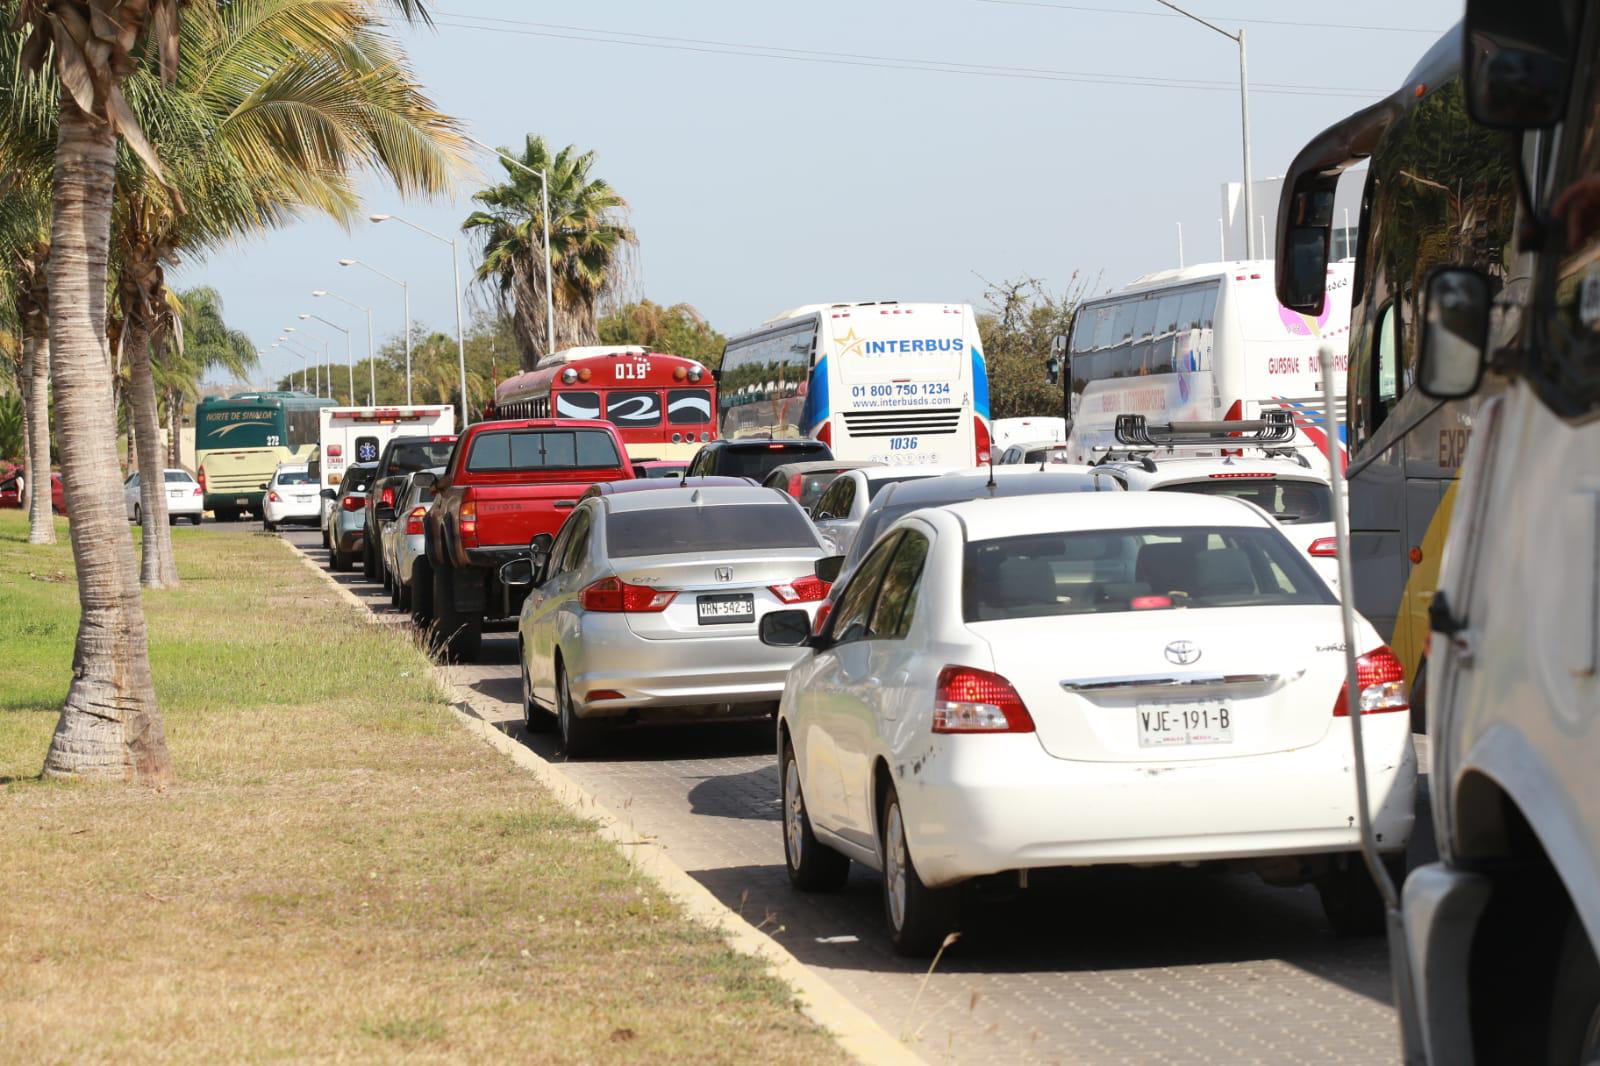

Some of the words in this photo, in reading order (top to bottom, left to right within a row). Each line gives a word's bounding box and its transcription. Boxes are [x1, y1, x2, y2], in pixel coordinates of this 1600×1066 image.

[865, 338, 964, 354] INTERBUS
[1268, 357, 1300, 374] GUASAVE
[852, 386, 866, 397] 01
[870, 385, 892, 396] 800
[896, 384, 917, 395] 750
[922, 383, 950, 394] 1234
[853, 397, 951, 408] www.interbusds.com
[207, 411, 229, 421] NORTE
[231, 411, 241, 420] DE
[242, 410, 273, 420] SINALOA
[890, 437, 918, 450] 1036
[700, 600, 753, 615] VRN-542-B
[1141, 708, 1230, 732] VJE-191-B
